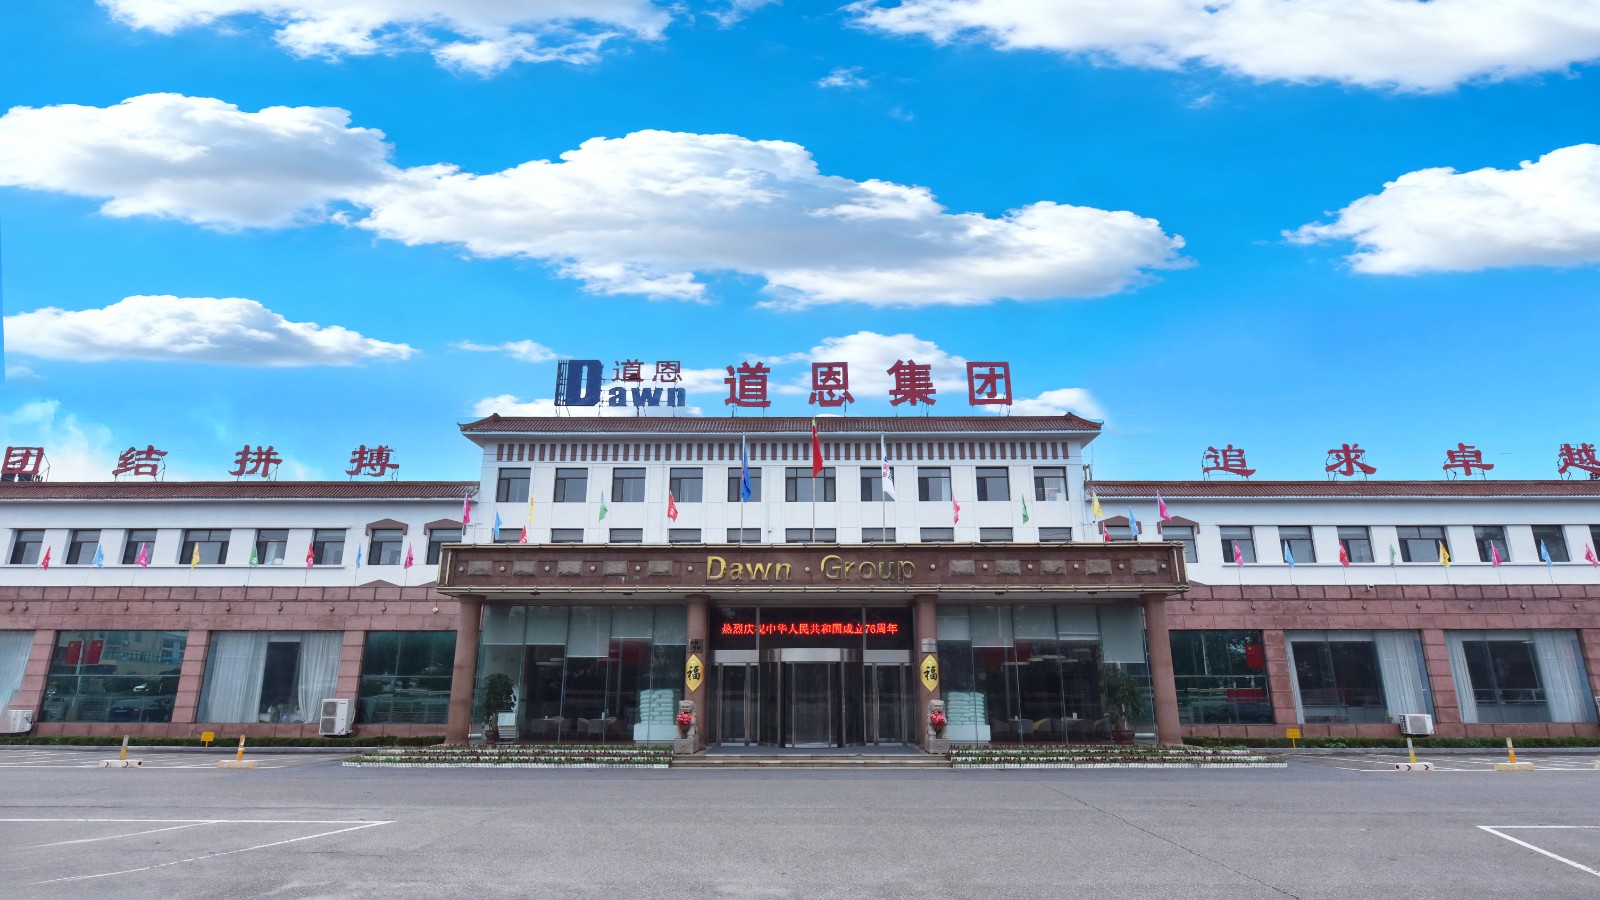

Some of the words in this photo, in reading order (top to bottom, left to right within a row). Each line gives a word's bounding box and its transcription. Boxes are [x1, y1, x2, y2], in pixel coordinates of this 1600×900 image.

[555, 359, 686, 407] Dawn
[612, 359, 682, 382] 道恩
[724, 359, 1012, 407] 道恩集团
[1, 444, 400, 477] 团结拼搏
[1203, 443, 1600, 476] 追求卓越
[706, 555, 793, 581] Dawn
[820, 554, 916, 584] Group
[687, 665, 701, 681] 福
[923, 665, 938, 681] 福
